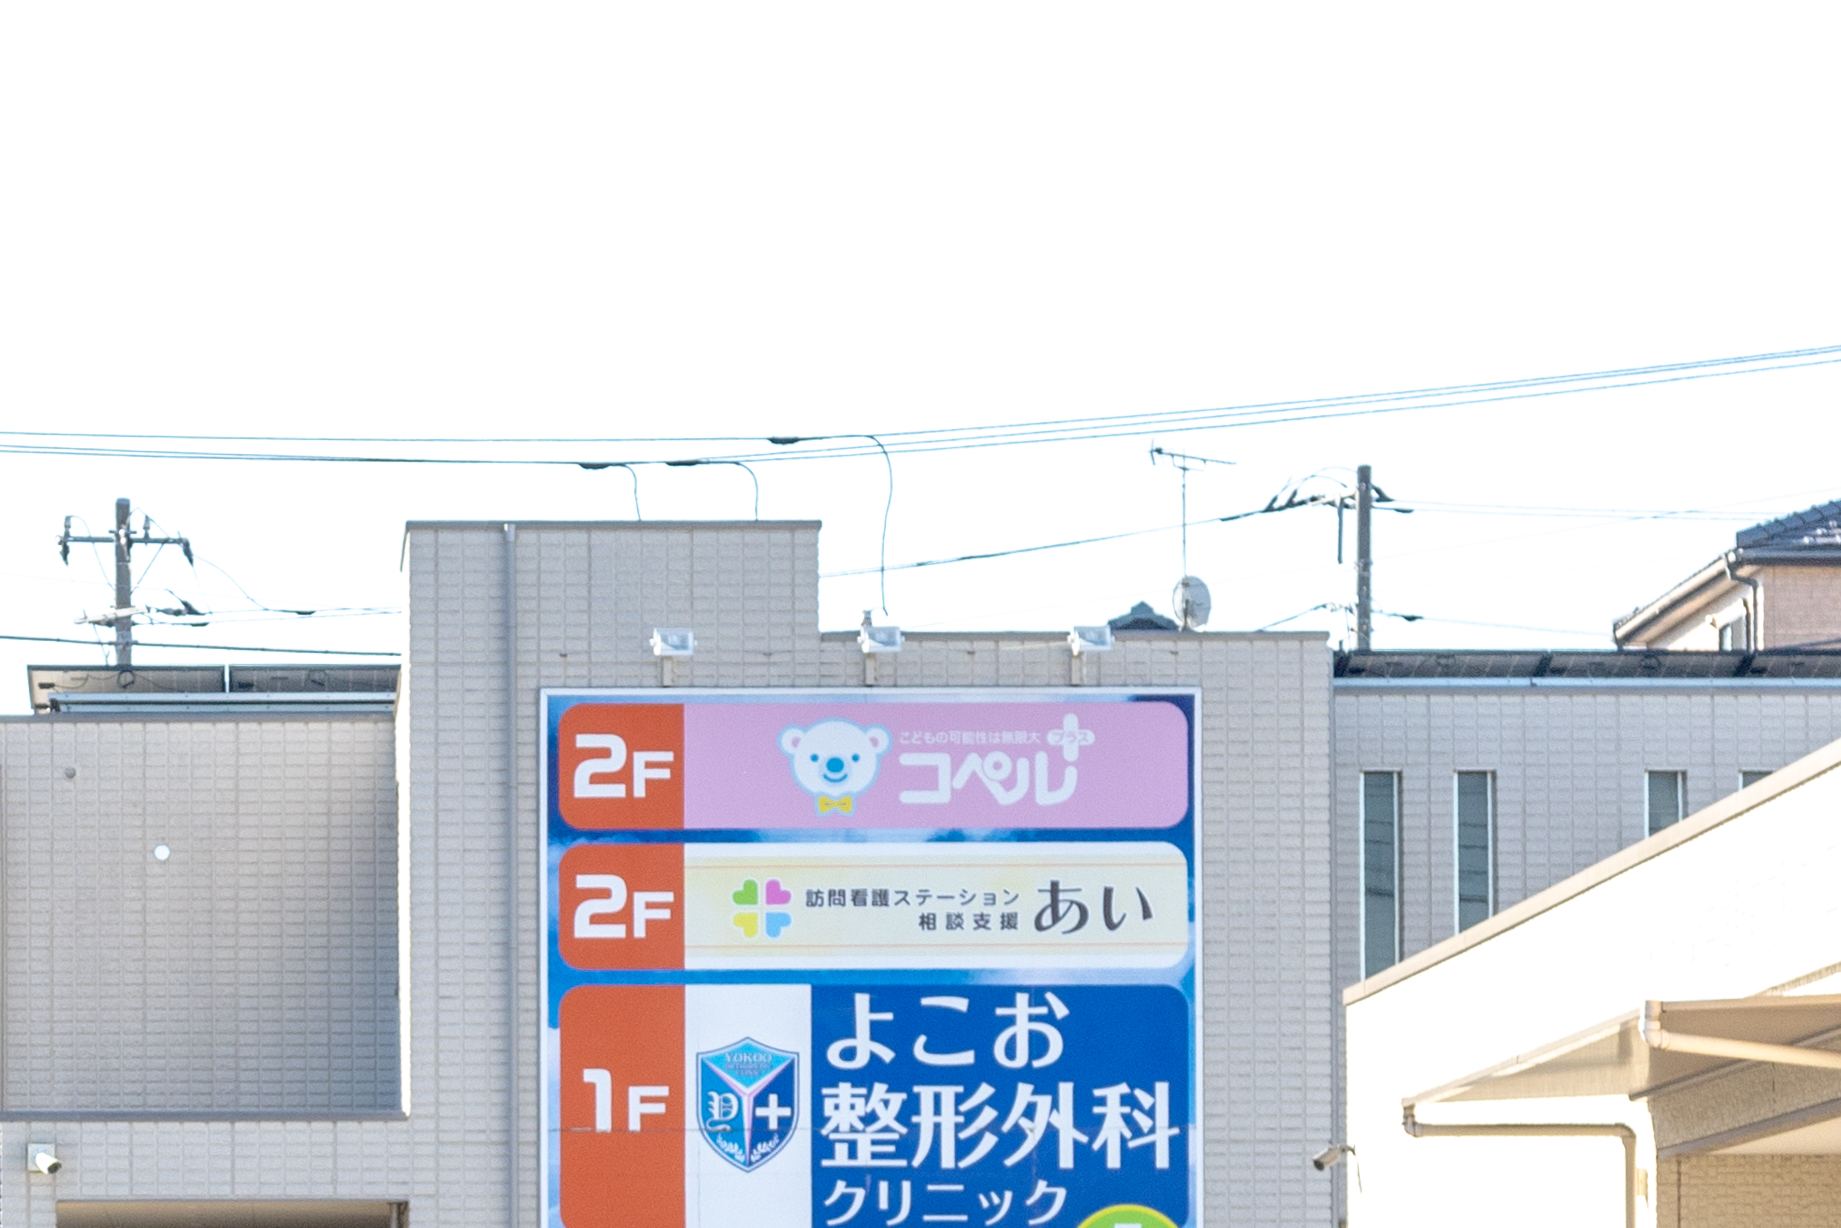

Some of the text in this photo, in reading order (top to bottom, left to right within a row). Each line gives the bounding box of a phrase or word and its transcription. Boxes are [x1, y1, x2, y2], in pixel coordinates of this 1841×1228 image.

[573, 733, 675, 799] 2F
[573, 873, 675, 939] 2F
[805, 889, 1020, 907] 訪問看護ステーション
[918, 911, 1020, 931] 相談支援
[1034, 880, 1154, 934] あい
[826, 991, 1070, 1069] よこお
[583, 1068, 670, 1133] 1F
[821, 1081, 1179, 1170] 整形外科
[824, 1179, 1068, 1227] クリニック
